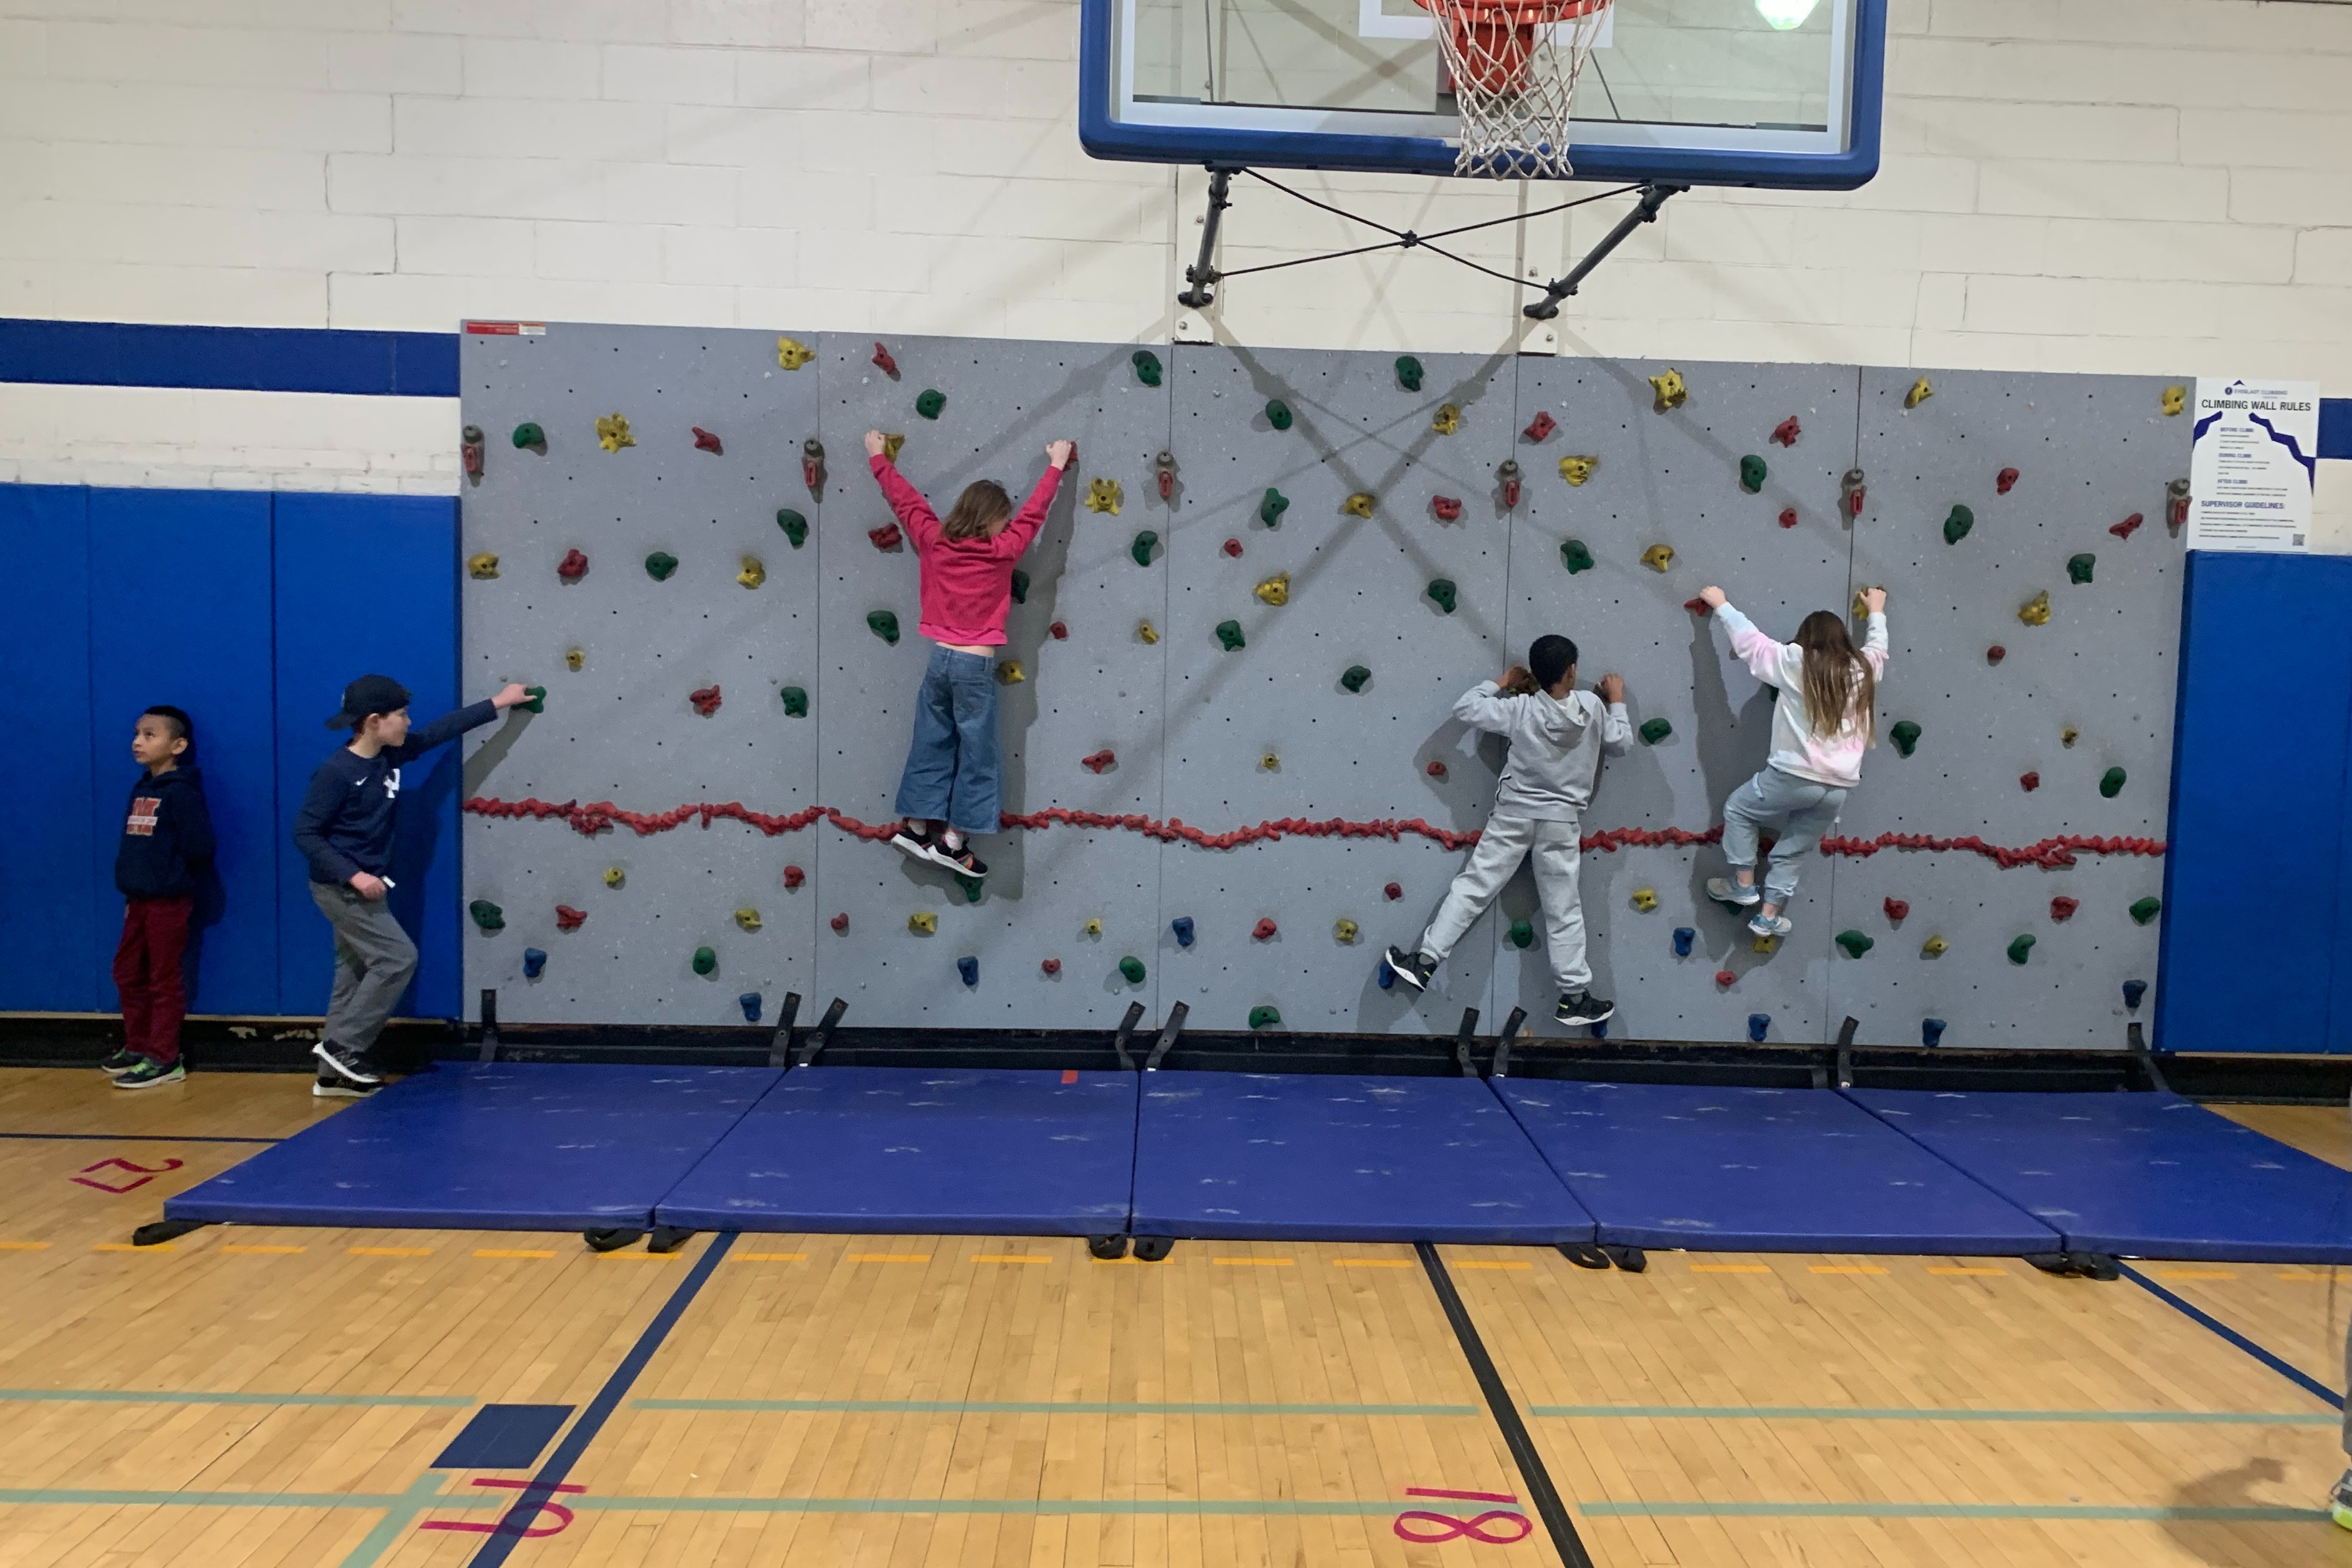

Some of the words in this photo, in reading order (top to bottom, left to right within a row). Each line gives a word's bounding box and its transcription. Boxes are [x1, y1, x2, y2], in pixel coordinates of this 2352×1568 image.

[2201, 399, 2248, 410] CLIMBING
[2251, 401, 2277, 410] WALL
[2280, 402, 2311, 411] RULES
[1394, 1488, 1533, 1544] 18
